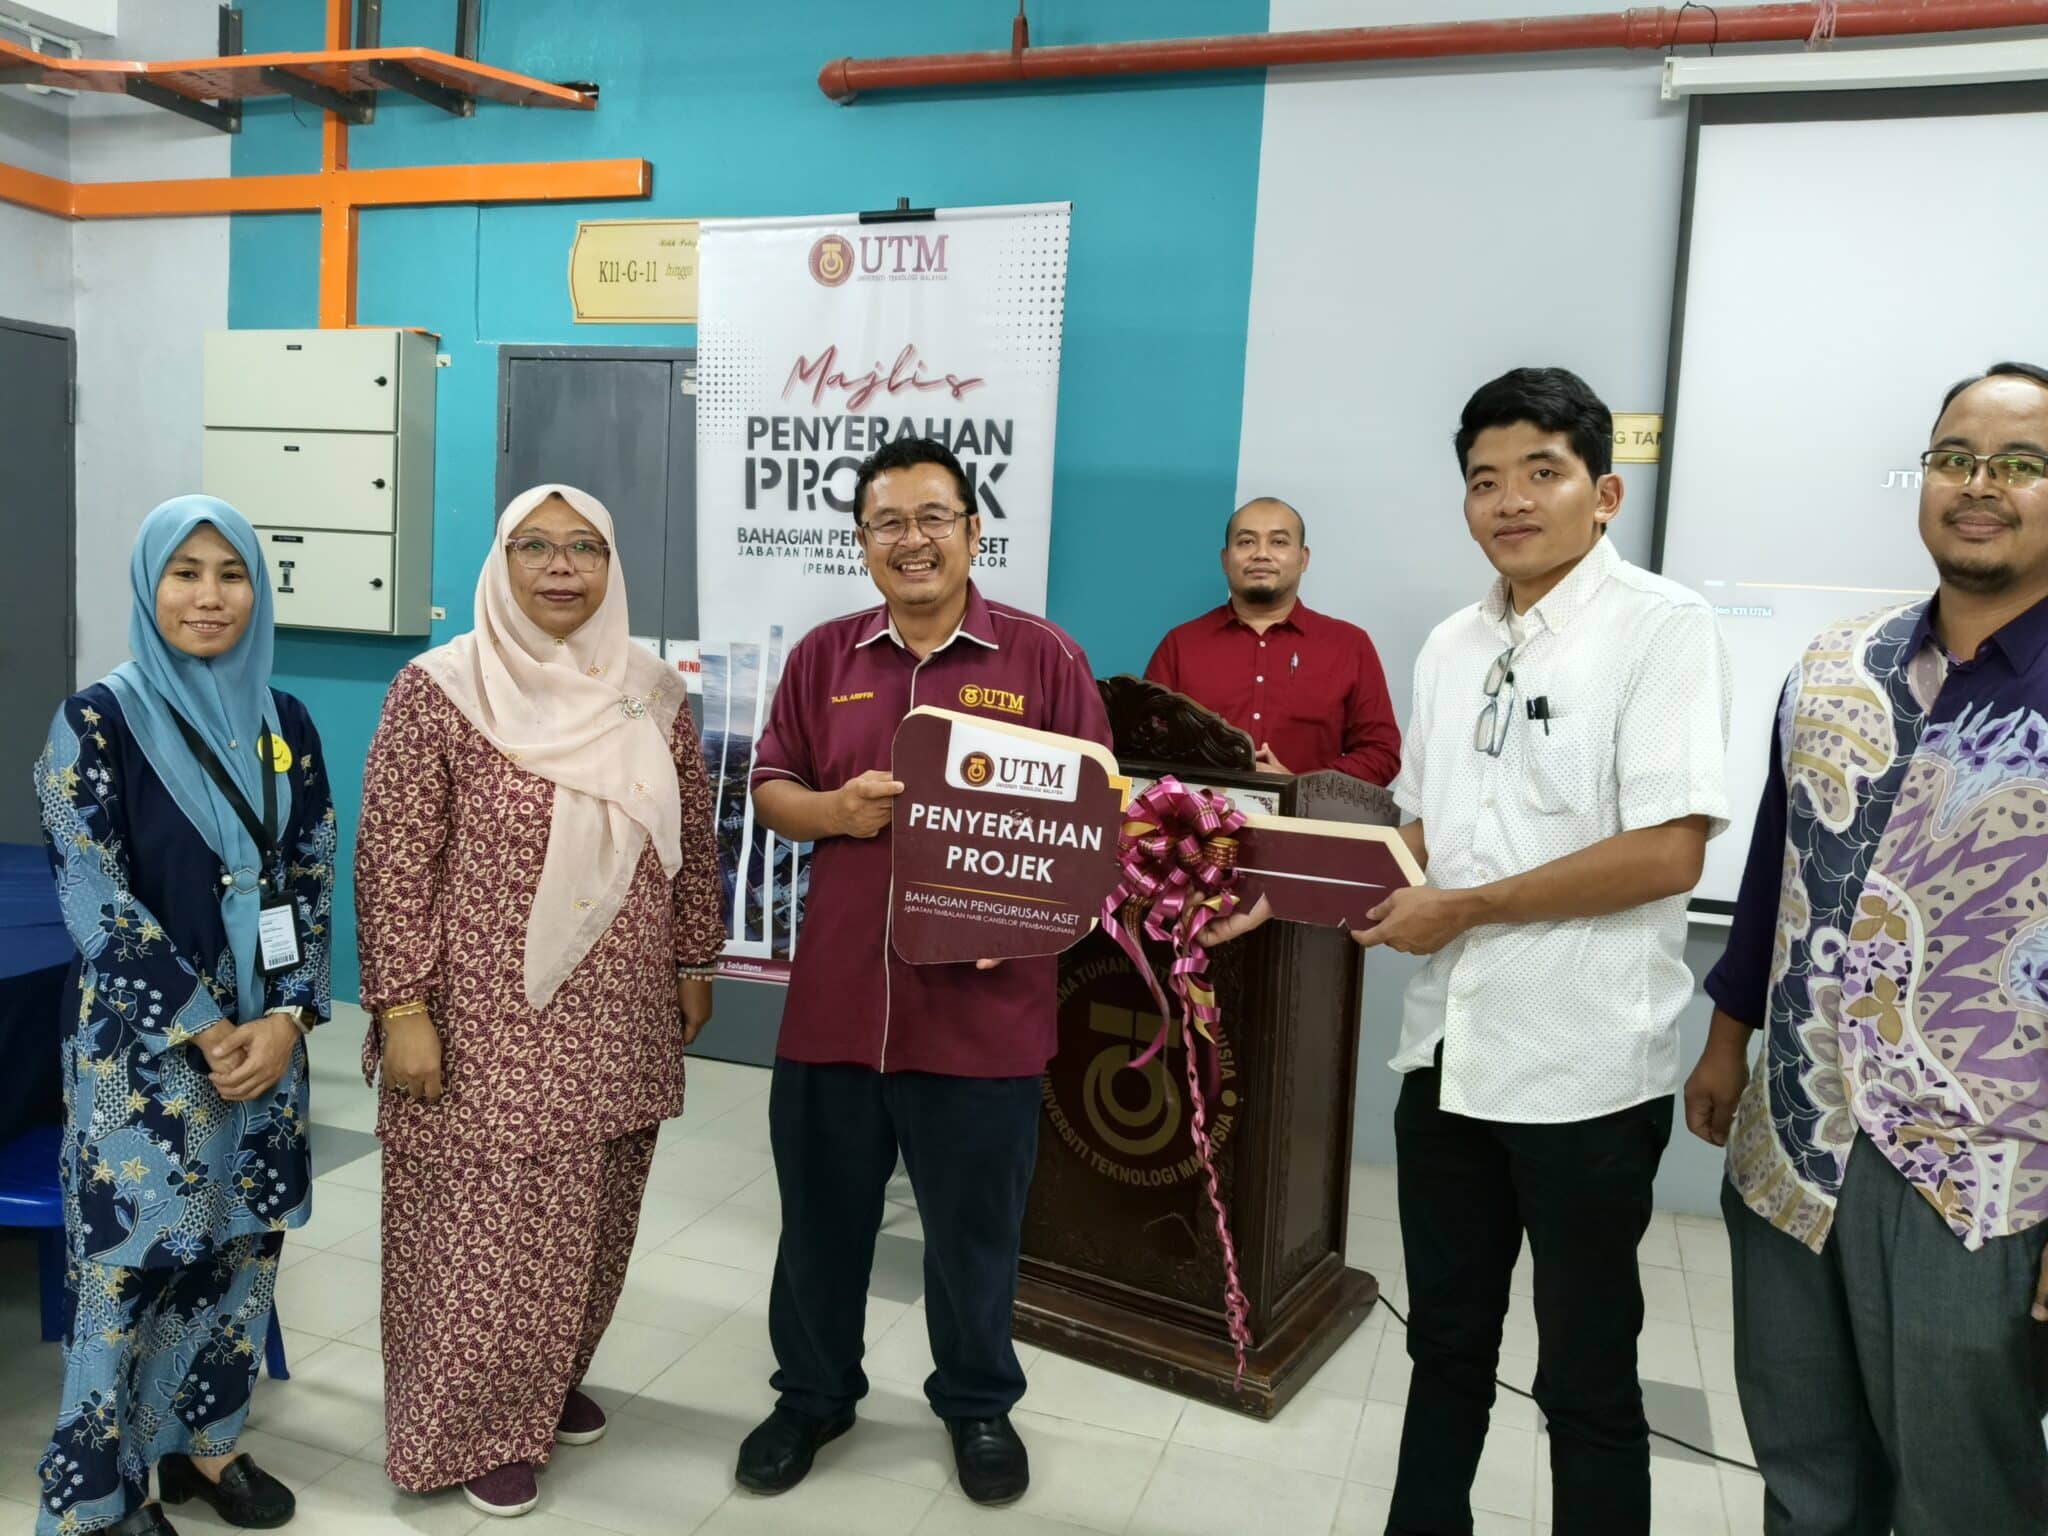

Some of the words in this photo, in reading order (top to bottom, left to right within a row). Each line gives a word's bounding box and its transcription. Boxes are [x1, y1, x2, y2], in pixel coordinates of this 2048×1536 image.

[859, 234, 949, 273] UTM
[781, 343, 985, 412] Majlis
[746, 415, 1014, 456] PENYERAHAN
[737, 526, 824, 546] BAHAGIAN
[978, 536, 1010, 556] SET
[738, 546, 800, 559] JABATAN
[803, 547, 865, 561] TIMBALA
[970, 556, 1008, 569] ELOR
[803, 562, 869, 577] (PEMBAN
[678, 660, 700, 673] HEND
[983, 688, 1025, 711] UTM
[999, 756, 1067, 789] UTM
[908, 803, 1103, 851] PENYERAHAN
[946, 845, 1055, 883] PROJEK
[905, 891, 968, 910] BAHAGIAN
[970, 900, 1050, 921] PENGURUSAN
[1050, 912, 1081, 926] ASET
[934, 908, 966, 919] TIMBALAN
[983, 916, 1018, 927] CANSELOR
[726, 961, 763, 973] Solutions
[1074, 957, 1131, 984] TUHAN
[1089, 1150, 1179, 1187] TEKNOLOGI
